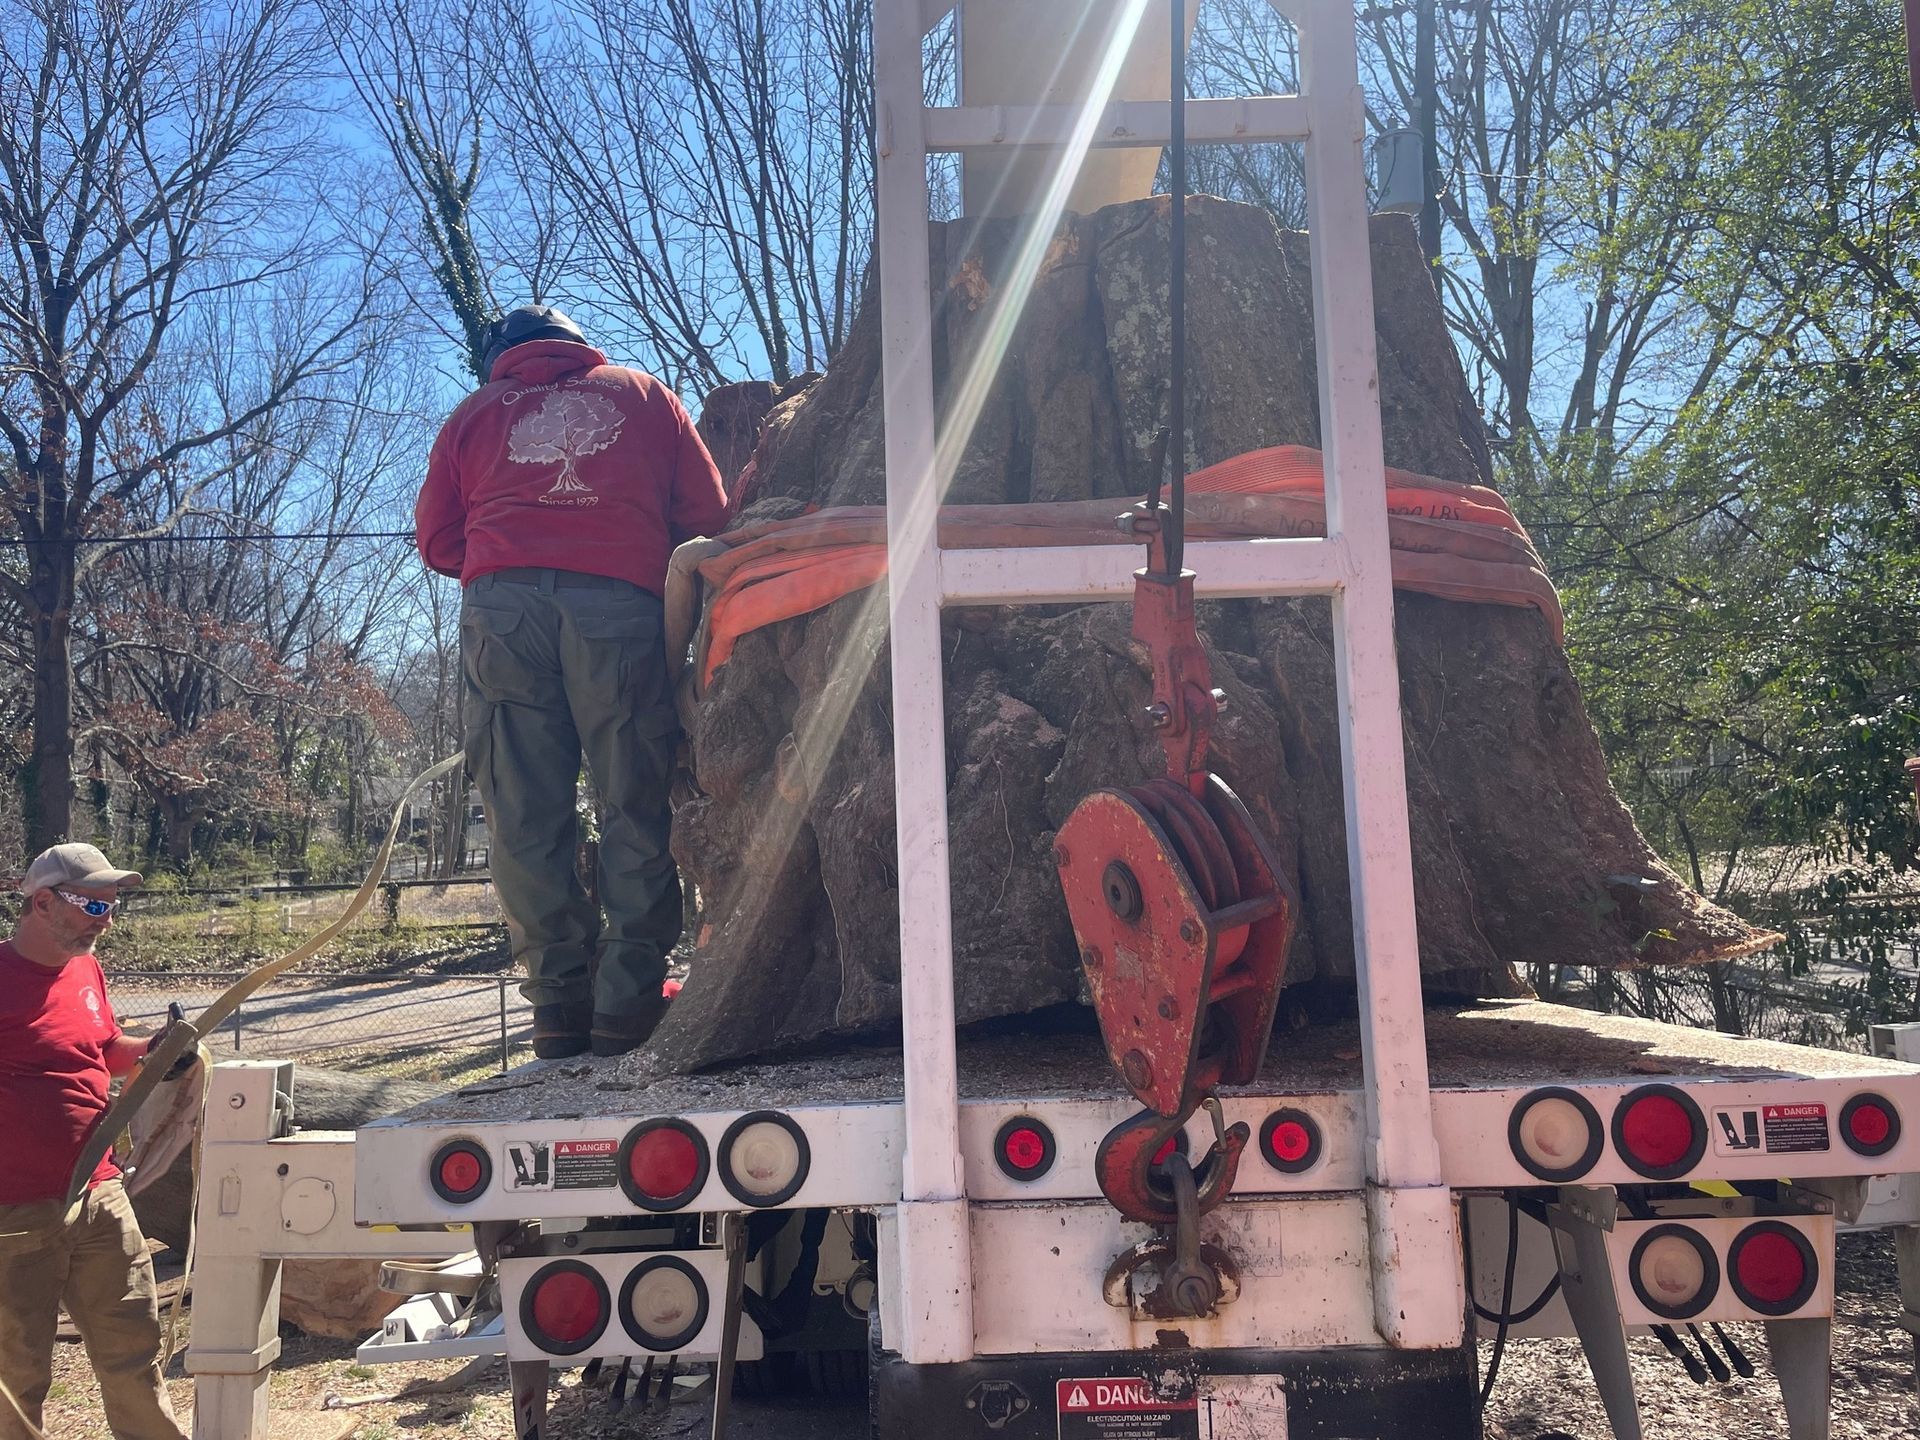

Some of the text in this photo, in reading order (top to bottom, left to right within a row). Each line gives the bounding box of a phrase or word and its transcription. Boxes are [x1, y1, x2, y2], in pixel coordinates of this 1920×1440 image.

[502, 376, 622, 405] Quality Service
[538, 495, 599, 507] Since 1979
[1784, 1107, 1819, 1116] DANGER
[576, 1143, 611, 1152] DANGER
[1096, 1385, 1174, 1405] DANG
[1087, 1415, 1142, 1423] ELECTROCUTION
